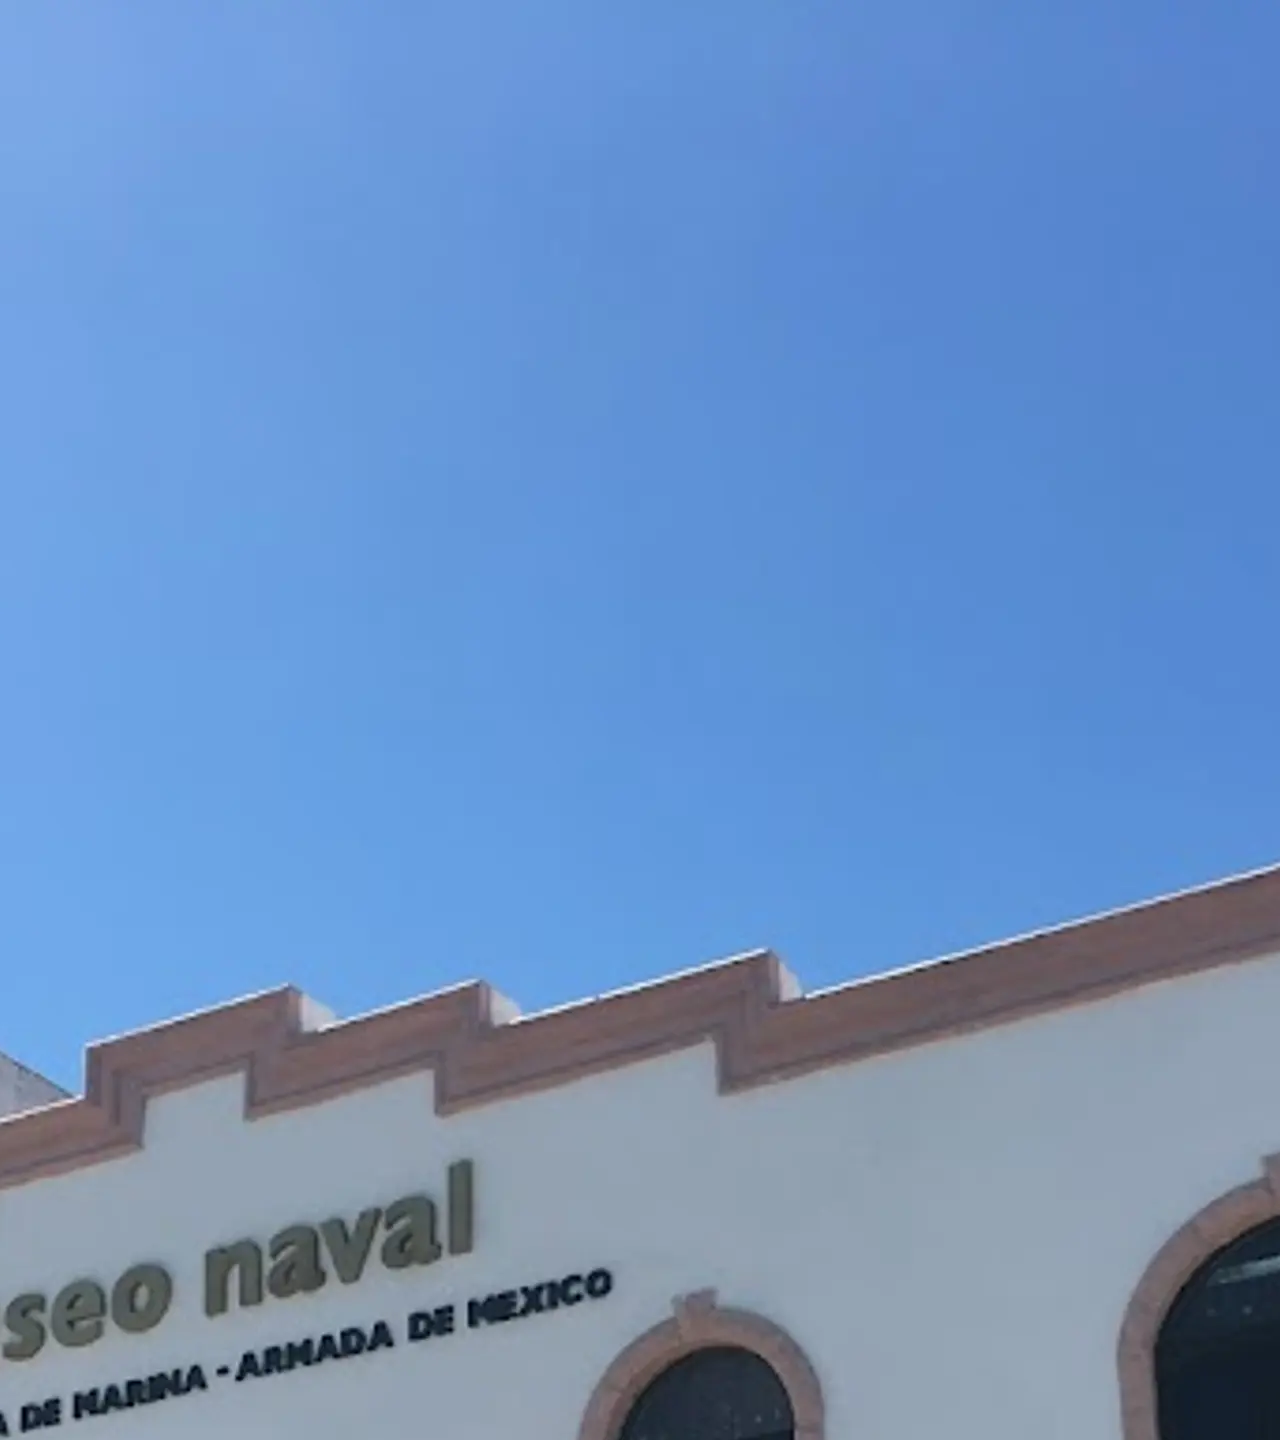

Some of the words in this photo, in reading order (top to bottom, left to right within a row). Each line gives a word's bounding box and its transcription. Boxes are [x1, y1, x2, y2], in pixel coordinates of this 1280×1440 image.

[204, 1159, 473, 1319] naval
[20, 1398, 61, 1432] DE
[73, 1365, 207, 1420] MARINA
[235, 1320, 394, 1383] ARMADA
[408, 1305, 455, 1342] DE
[467, 1268, 613, 1330] MEXICO
